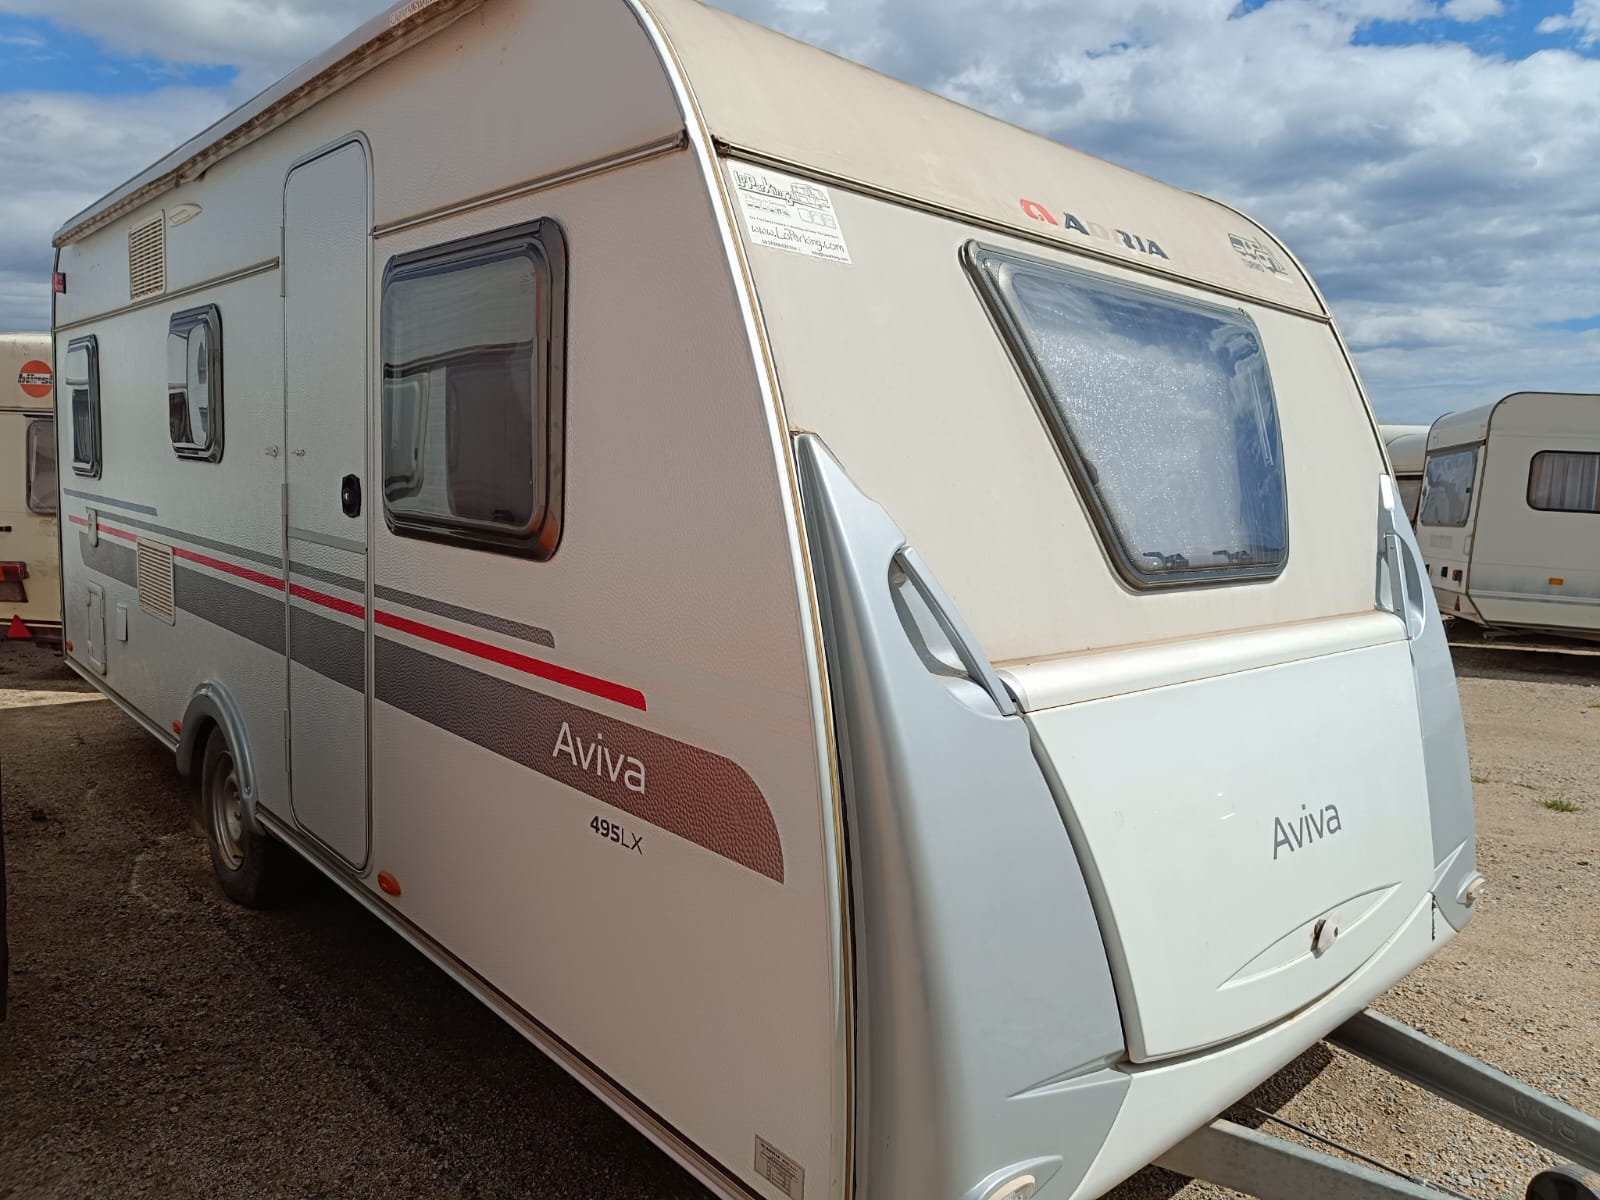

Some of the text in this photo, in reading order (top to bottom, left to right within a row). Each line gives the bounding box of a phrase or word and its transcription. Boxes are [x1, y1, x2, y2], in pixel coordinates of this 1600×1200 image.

[552, 721, 646, 795] Aviva
[590, 815, 643, 856] 495LX
[1273, 803, 1342, 861] Aviva
